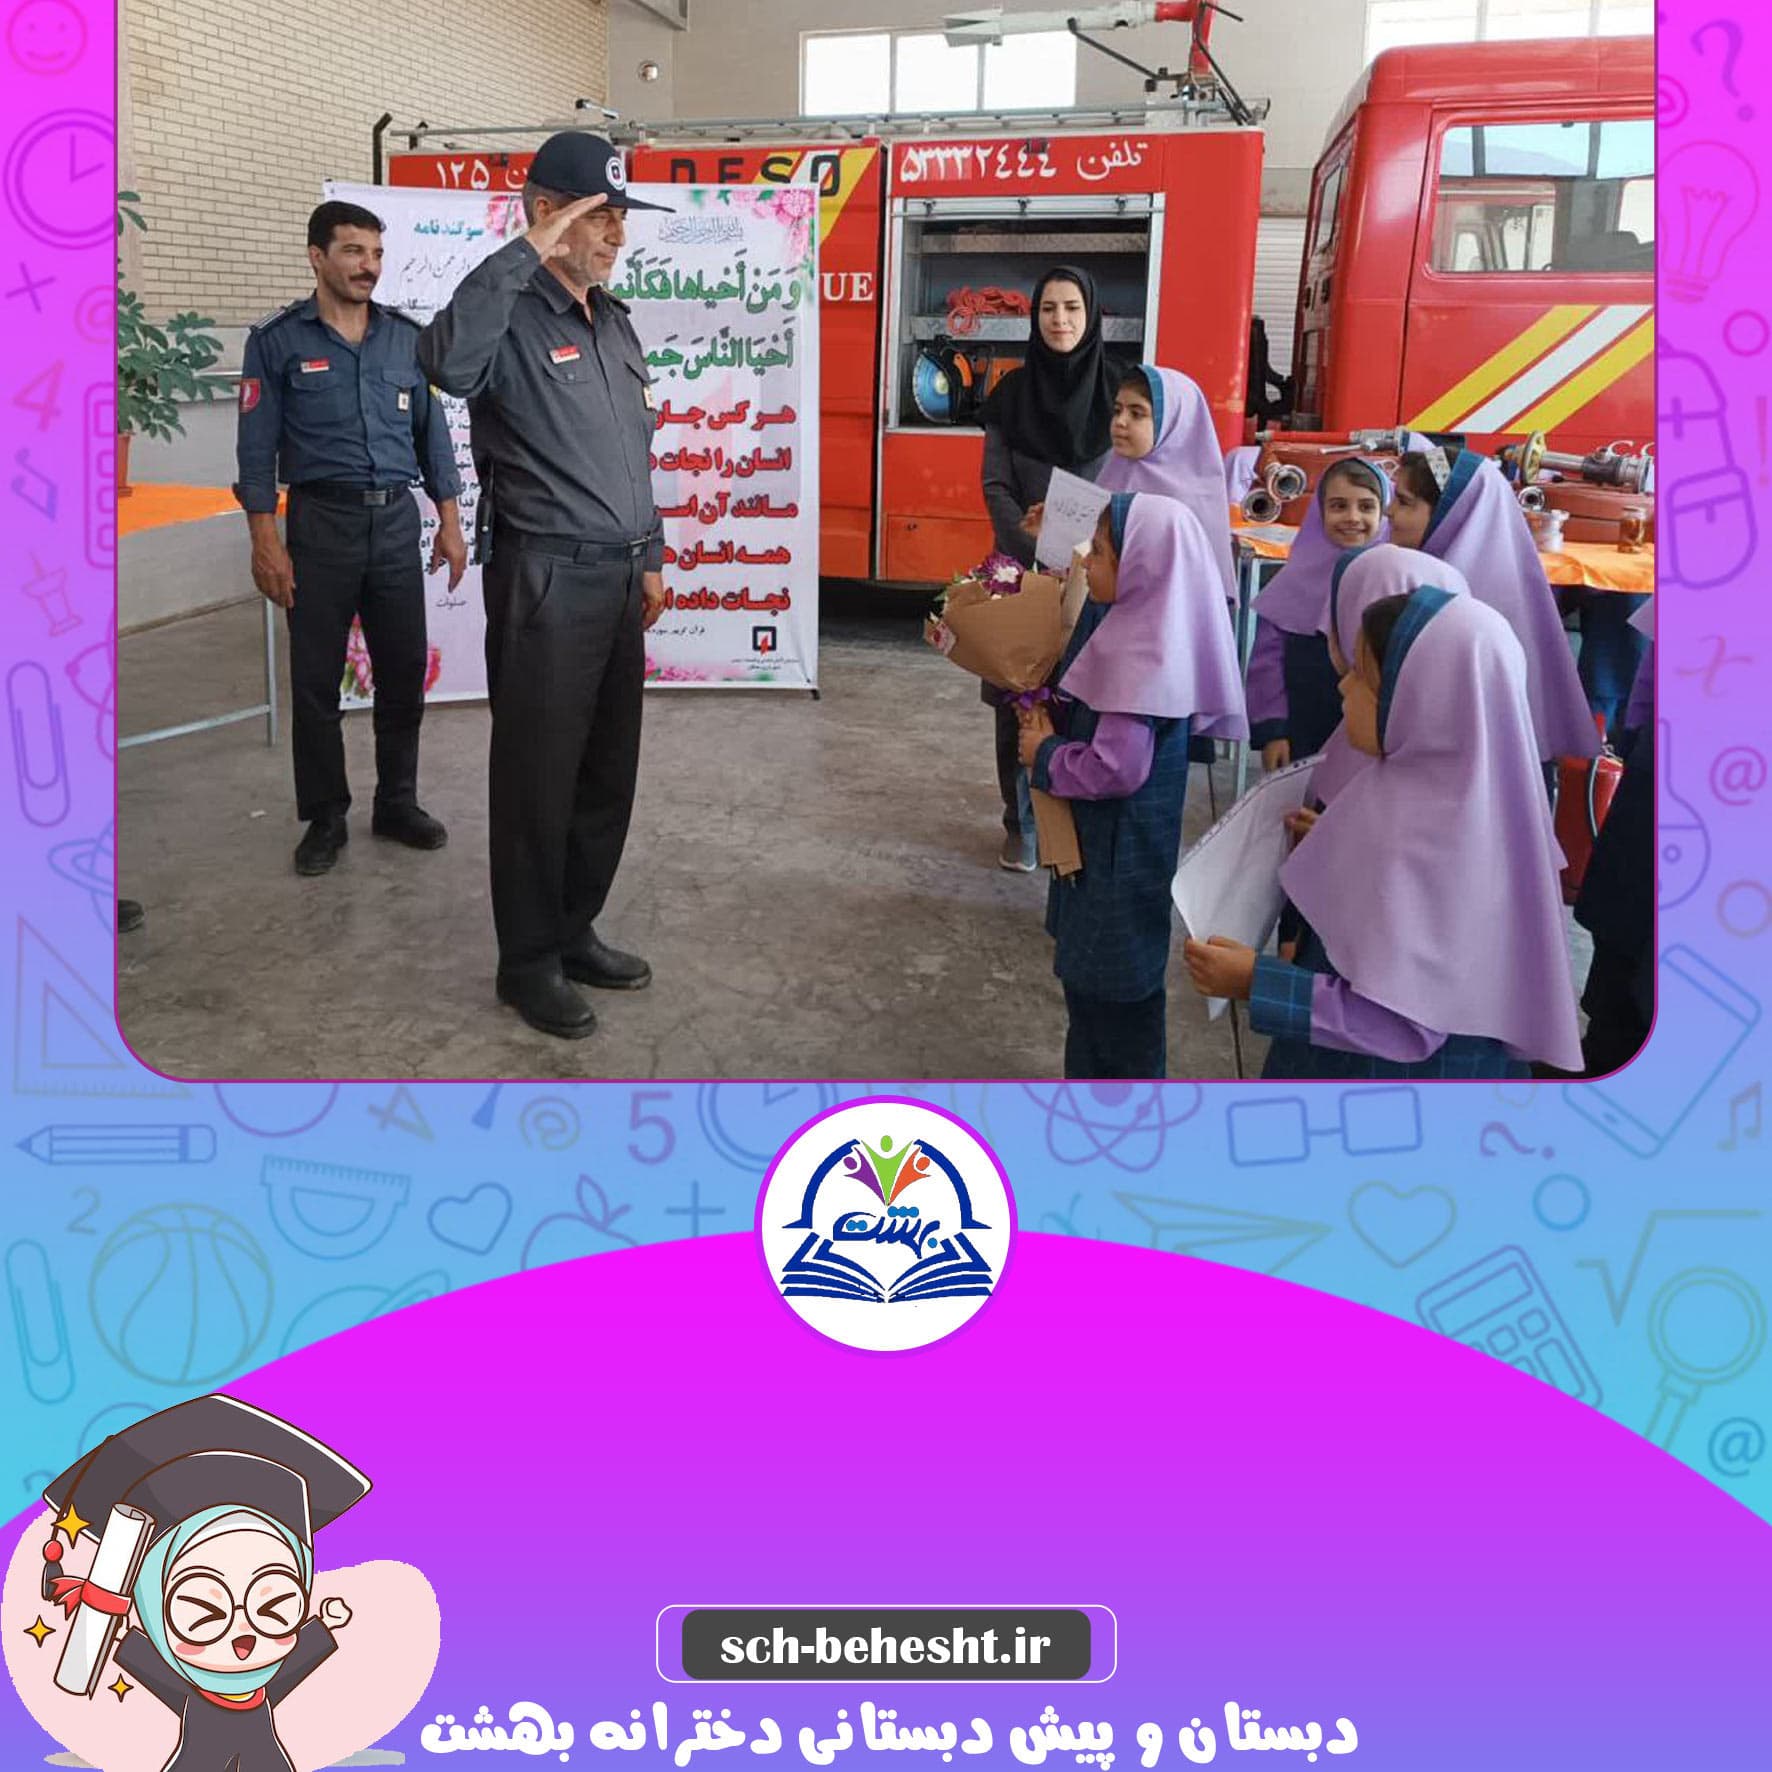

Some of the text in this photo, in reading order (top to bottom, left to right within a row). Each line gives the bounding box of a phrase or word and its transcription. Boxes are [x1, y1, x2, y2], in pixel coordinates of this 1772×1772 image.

[1077, 139, 1148, 181] تلفن
[820, 272, 874, 301] UE
[707, 400, 750, 431] کس
[752, 404, 797, 431] هر
[659, 447, 713, 477] نجات
[714, 446, 734, 478] را
[735, 446, 793, 477] انسان
[698, 491, 731, 525] آن
[730, 494, 799, 518] مانند
[678, 540, 735, 571] انسان
[735, 545, 792, 565] همه
[675, 586, 720, 610] داده
[721, 586, 792, 617] نجات
